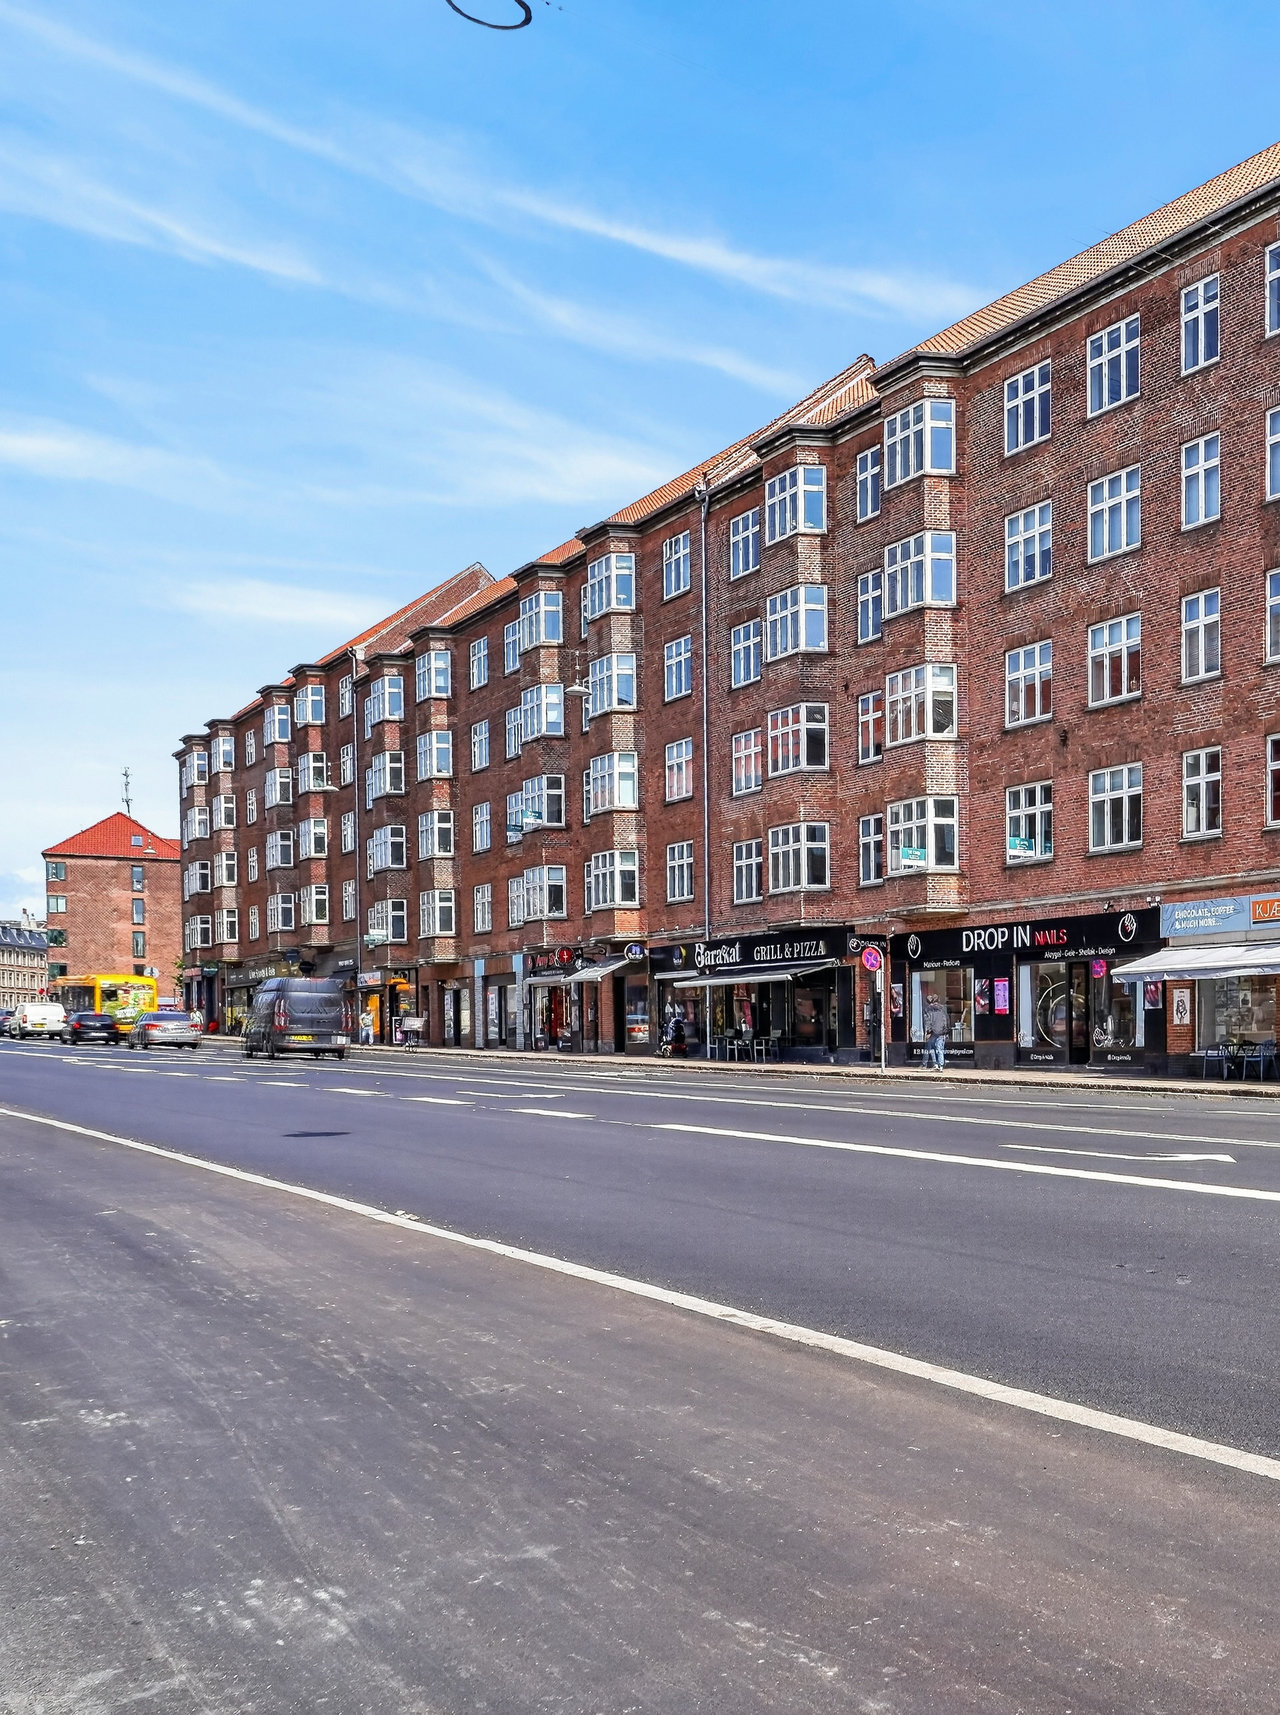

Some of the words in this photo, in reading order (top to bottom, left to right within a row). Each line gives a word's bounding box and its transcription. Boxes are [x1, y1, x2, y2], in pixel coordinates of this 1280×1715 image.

[1174, 907, 1211, 920] CHOCOLATE,
[1211, 904, 1235, 916] COFFEE
[1175, 921, 1181, 930] &
[1181, 919, 1198, 929] MUCH
[962, 927, 1008, 952] DROP
[1013, 925, 1030, 948] IN
[1034, 929, 1067, 946] NAILS
[754, 944, 783, 961] GRILL
[784, 942, 793, 958] &
[793, 940, 826, 958] PIZZA
[1098, 946, 1116, 955] Design
